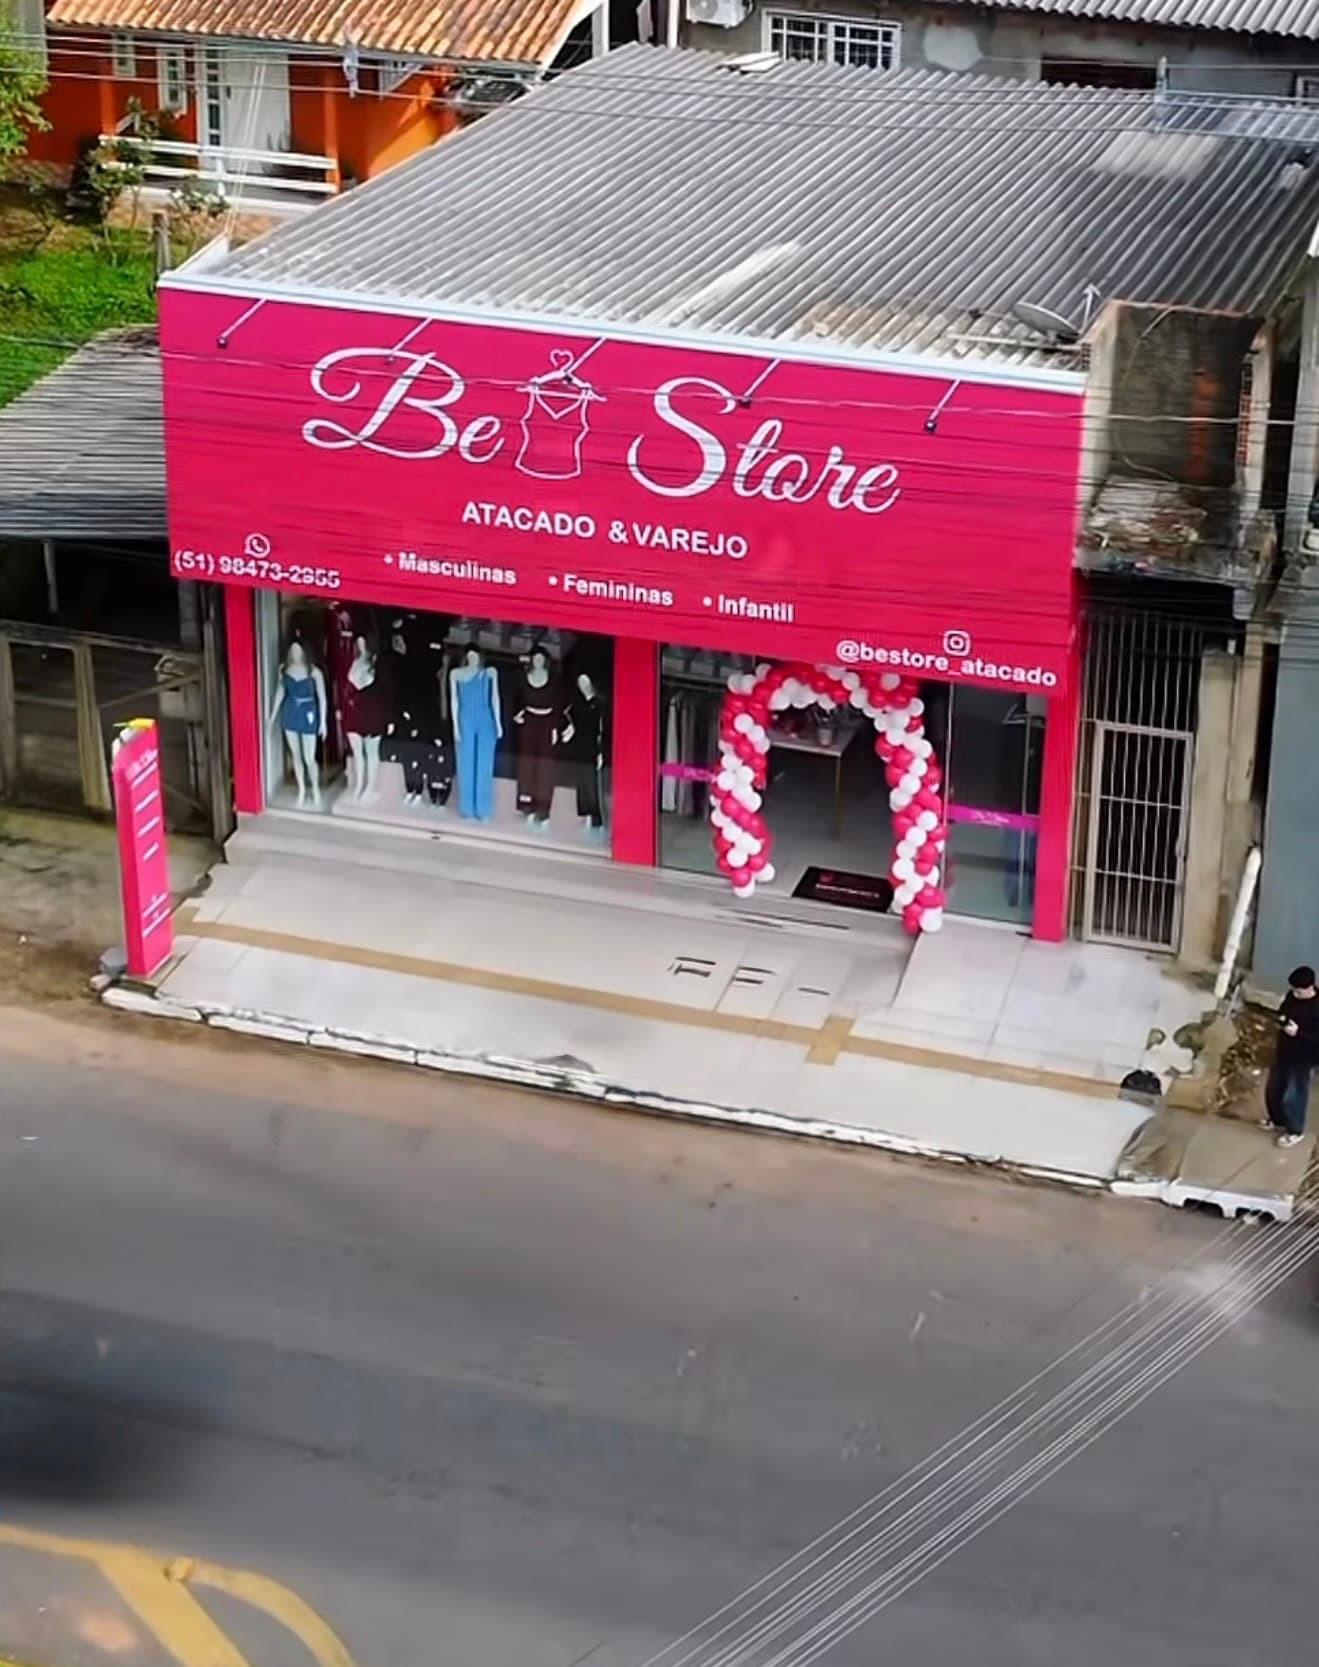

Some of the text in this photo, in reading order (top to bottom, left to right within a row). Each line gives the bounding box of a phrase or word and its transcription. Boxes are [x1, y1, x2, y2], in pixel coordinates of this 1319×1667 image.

[303, 347, 900, 514] Be Store
[461, 502, 596, 539] ATACADO
[632, 522, 749, 560] VAREJO
[174, 550, 216, 575] (51)
[398, 553, 795, 624] Masculinas Femininas Infantil
[836, 640, 1057, 687] @bestore_atacado
